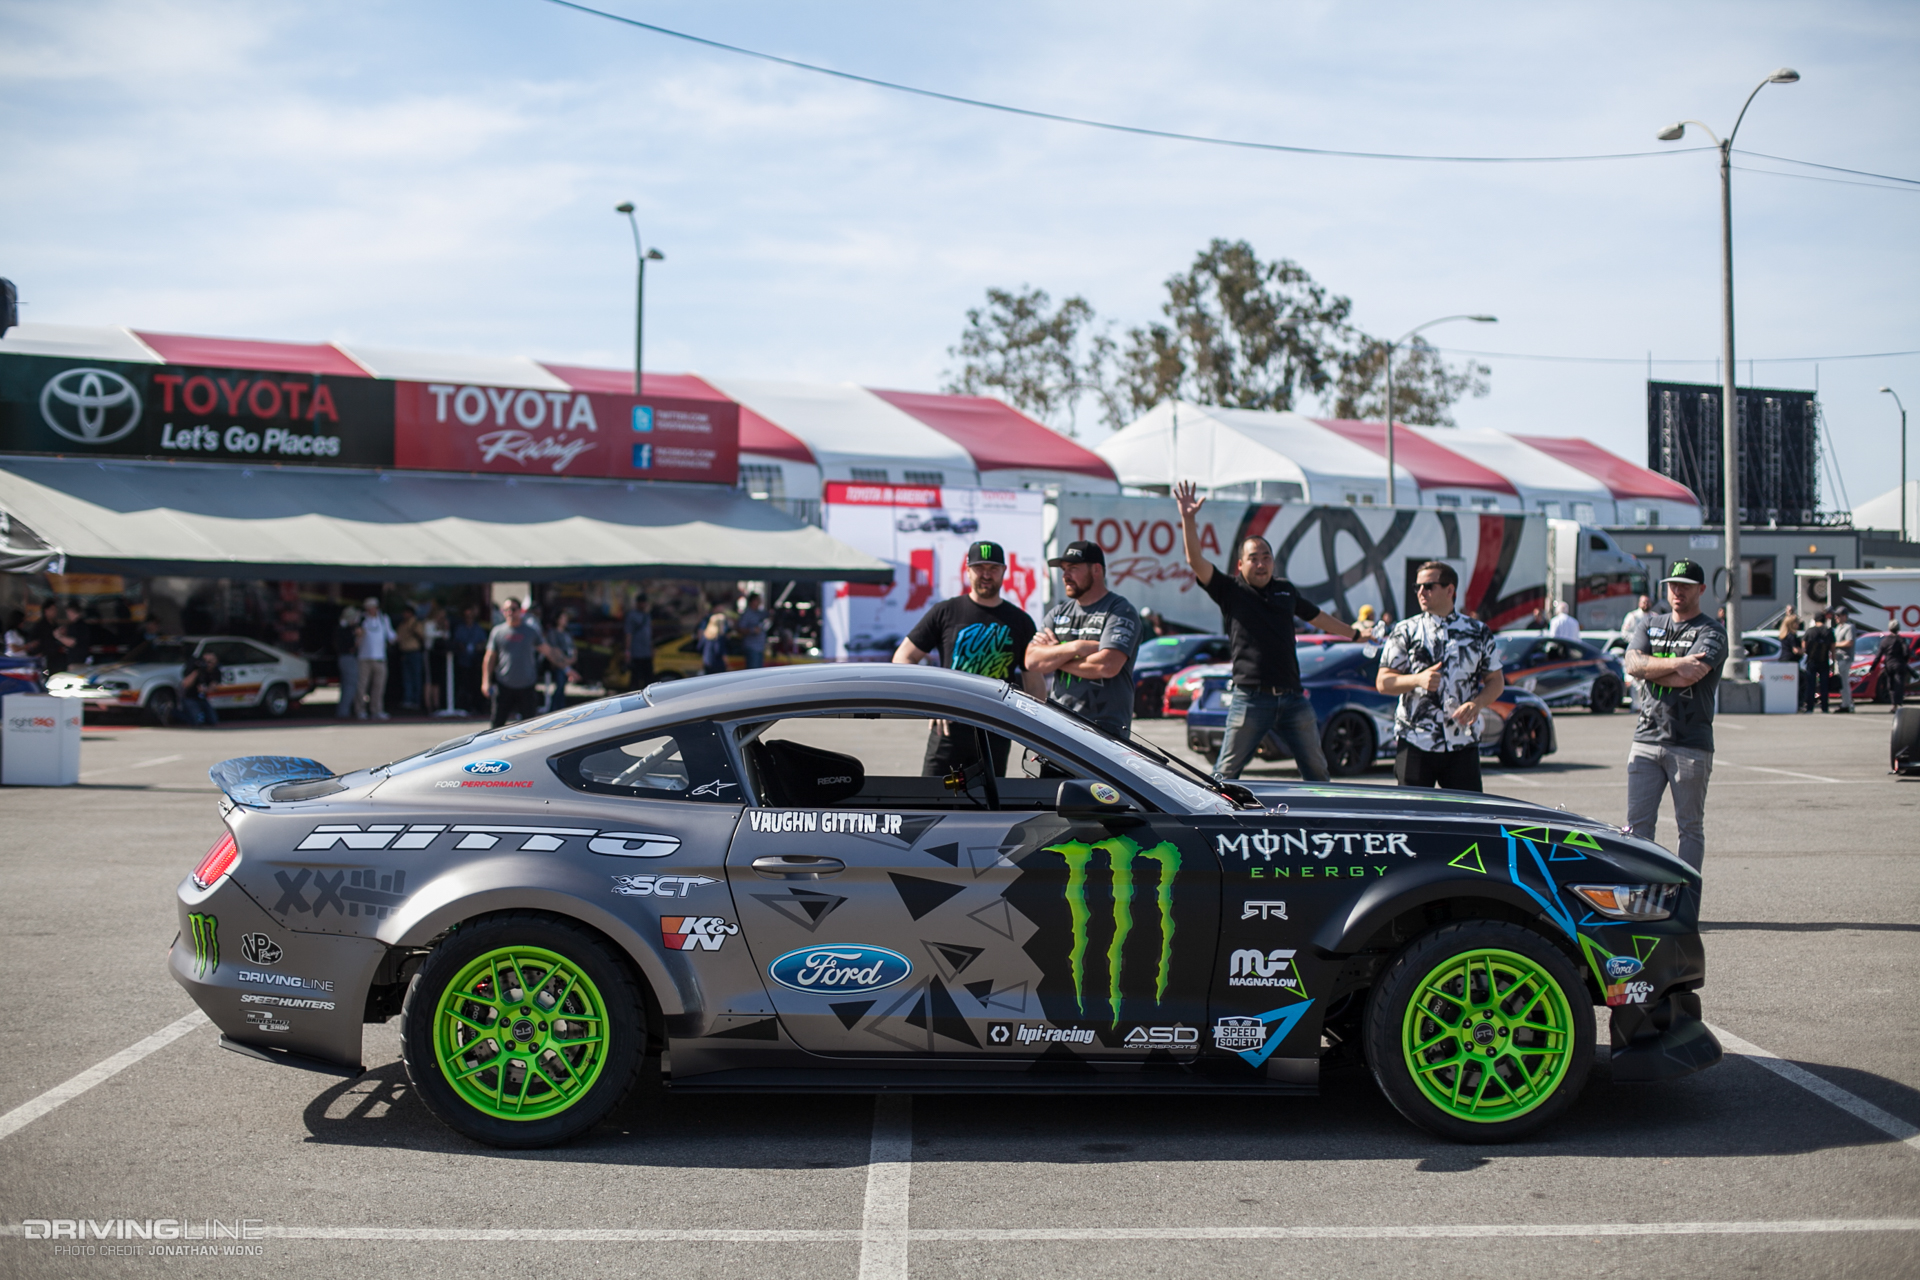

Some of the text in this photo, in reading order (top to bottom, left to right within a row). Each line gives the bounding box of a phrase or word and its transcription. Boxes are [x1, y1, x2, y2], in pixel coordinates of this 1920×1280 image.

[154, 374, 339, 422] TOYOTA
[428, 384, 597, 431] TOYOTA
[161, 424, 341, 456] Let's Go Places
[477, 430, 597, 472] Racing
[1070, 517, 1222, 556] TOYOA
[471, 761, 502, 773] Ford
[817, 776, 852, 785] RECARO
[750, 811, 902, 834] VAUGHN GITTIN JR
[295, 824, 681, 857] NITTO
[1216, 828, 1417, 861] MONSTER
[1251, 866, 1387, 878] ENERGY
[620, 875, 716, 898] SCT
[797, 951, 884, 986] Ford
[1611, 960, 1634, 974] Ford
[239, 971, 334, 992] DRIVINGLINE
[1229, 978, 1297, 987] MAGNAFLOW
[1124, 1026, 1199, 1043] ASD
[1220, 1038, 1258, 1047] SOCIETY
[1222, 1027, 1257, 1037] SPEED
